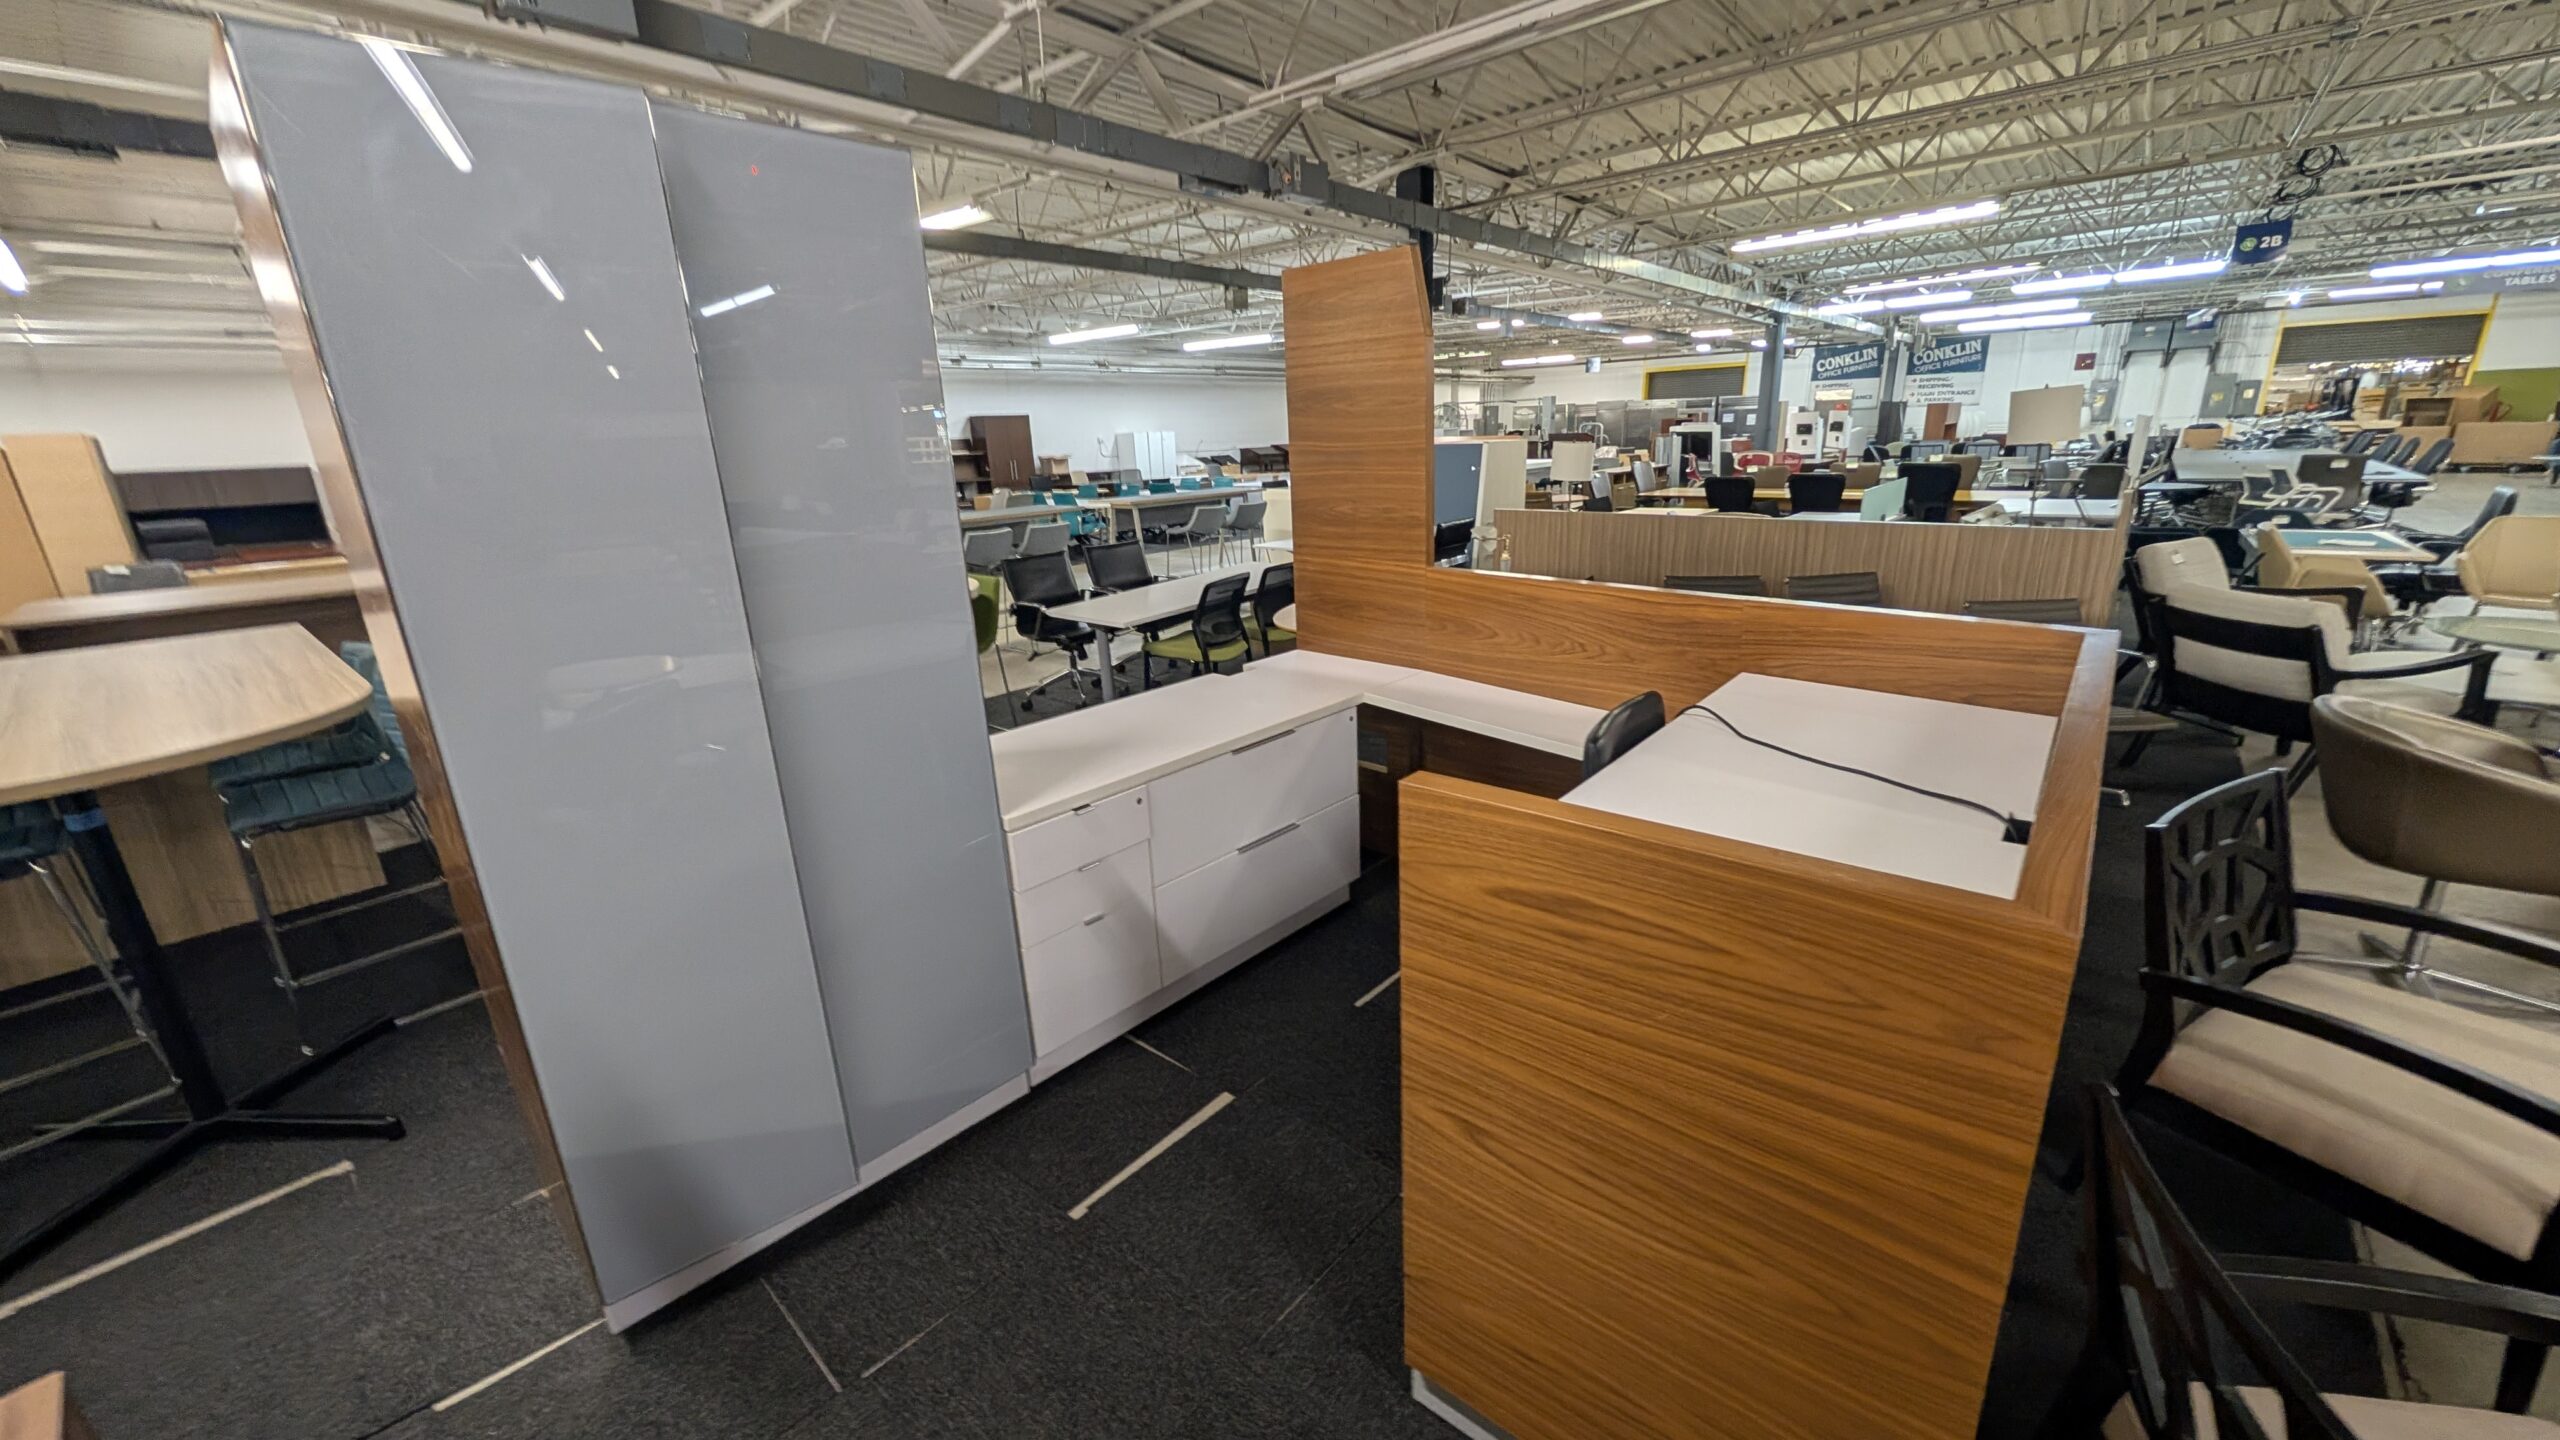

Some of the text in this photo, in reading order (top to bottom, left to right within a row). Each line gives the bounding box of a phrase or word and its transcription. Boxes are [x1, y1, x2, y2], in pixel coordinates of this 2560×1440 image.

[2259, 235, 2283, 248] 2B
[2505, 273, 2557, 286] TABLES
[1816, 346, 1878, 372] CONKLIN
[1912, 339, 1983, 366] CONKLIN
[1817, 360, 1879, 379] OFFICE FURNITURE
[1914, 353, 1983, 373] OFFICE FURNITURE
